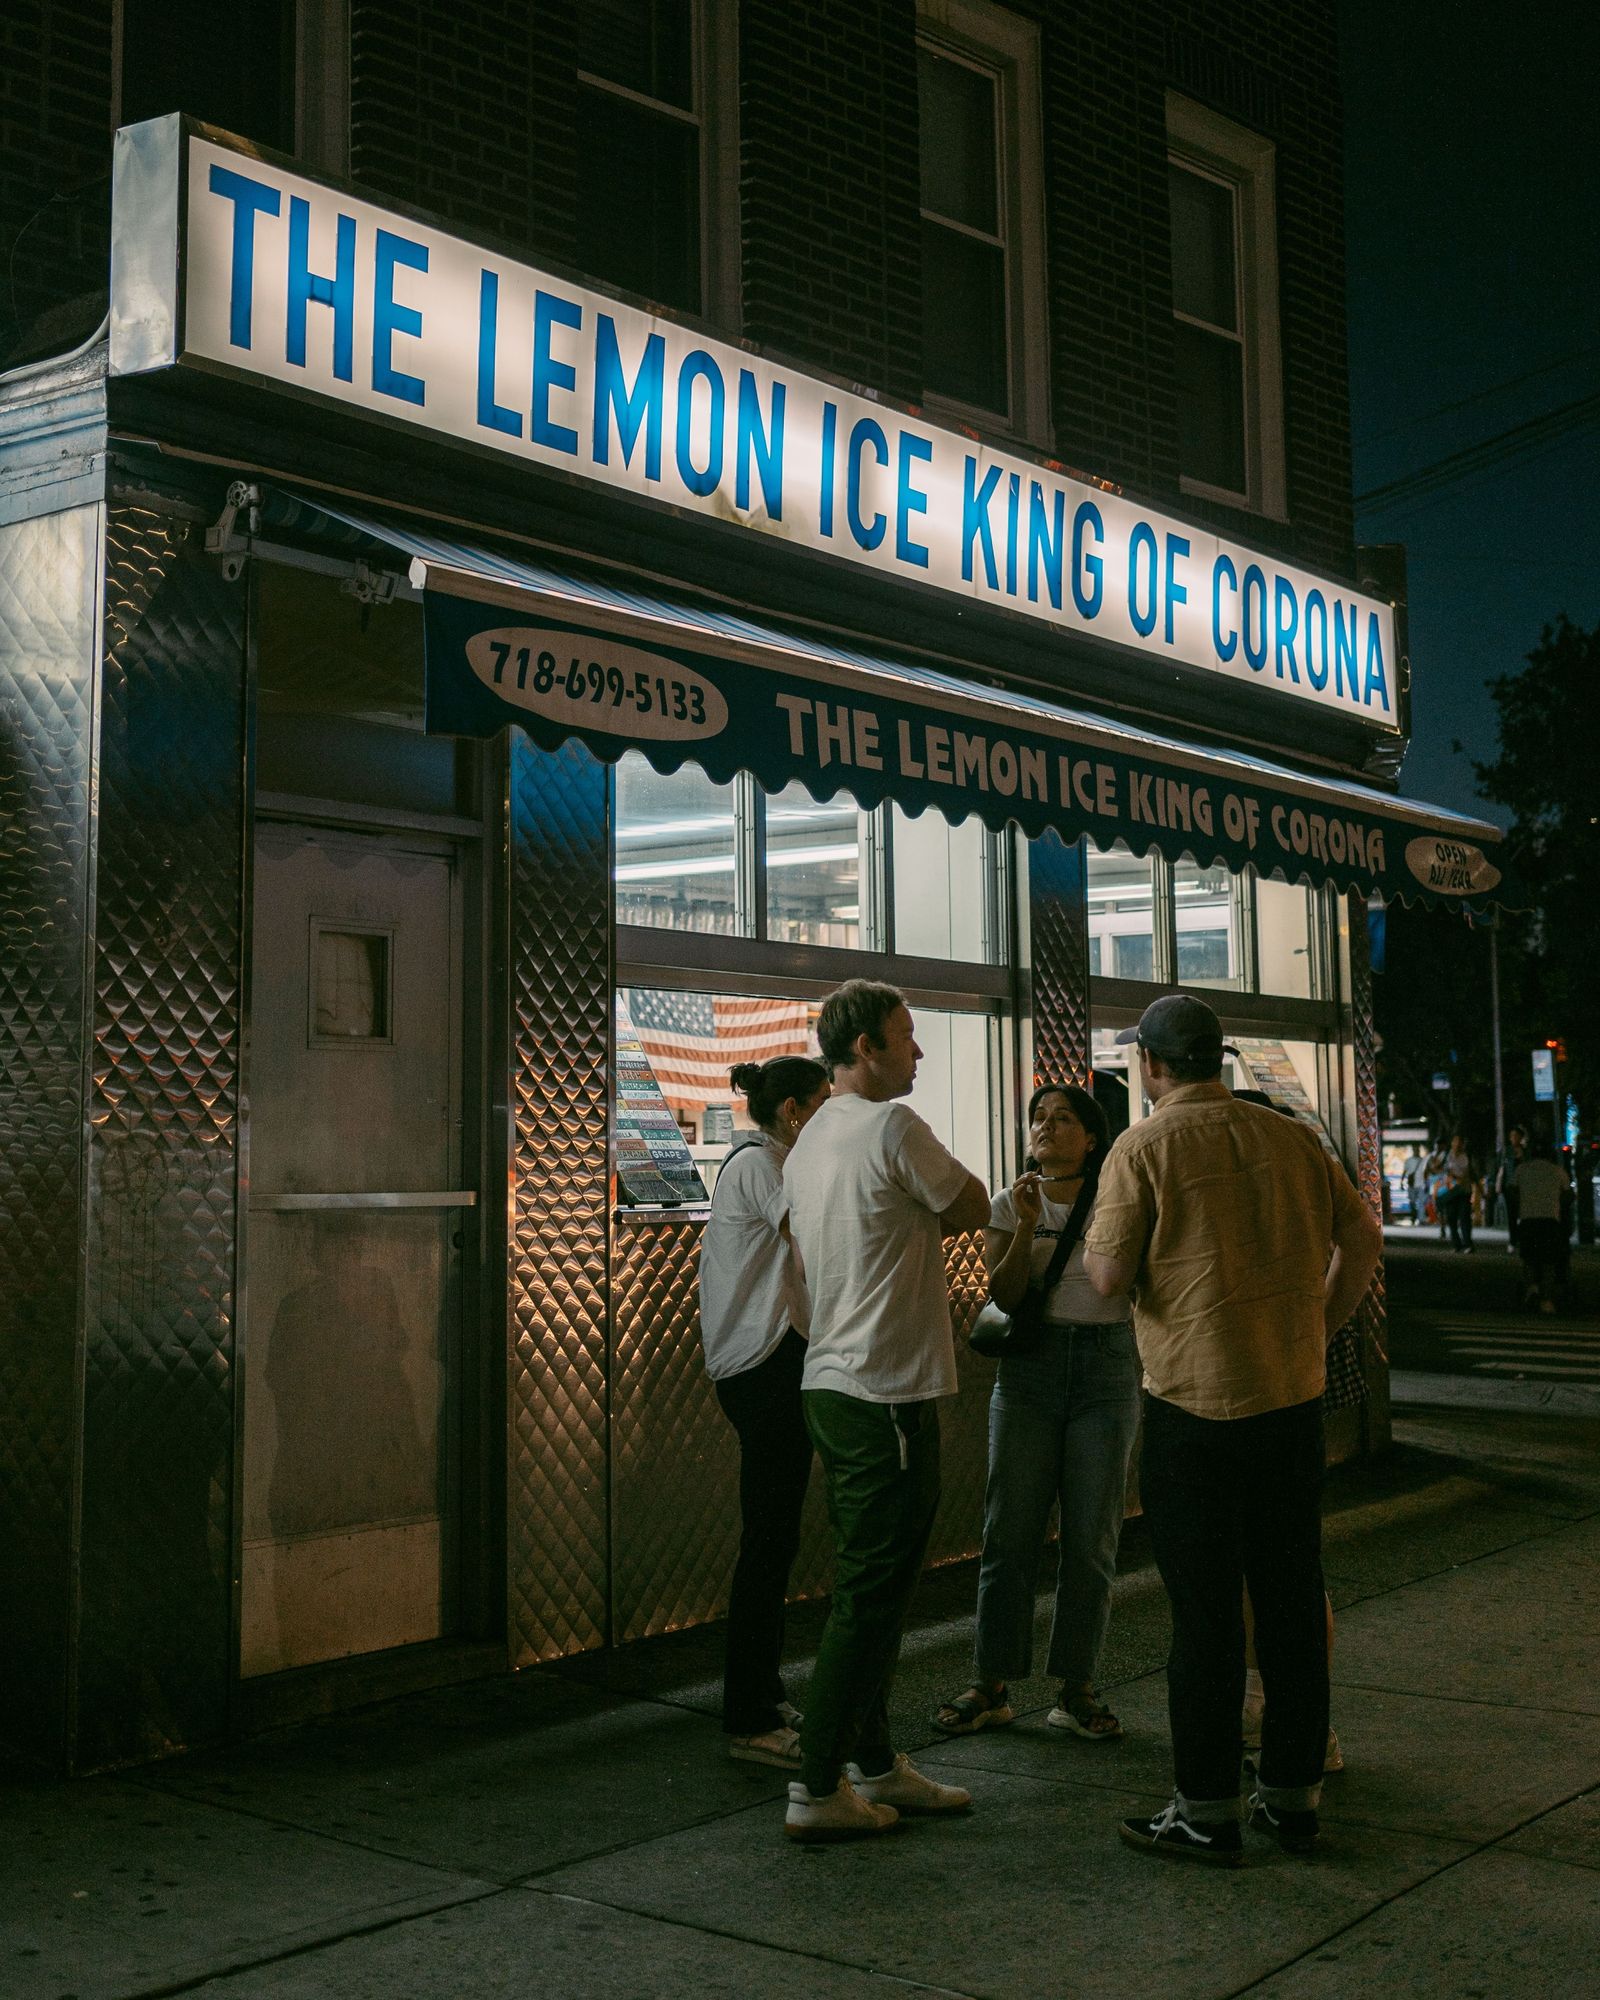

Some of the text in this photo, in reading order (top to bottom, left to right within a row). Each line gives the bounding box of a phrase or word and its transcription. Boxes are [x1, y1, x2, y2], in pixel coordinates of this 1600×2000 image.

[209, 163, 1390, 712] THE LEMON ICE KING OF CORONA
[489, 640, 707, 725] 718-699-5133
[776, 692, 1386, 877] THE LEMON ICE KING OF CORONA
[1435, 842, 1467, 866] OPEN
[652, 1150, 682, 1159] GRAPE
